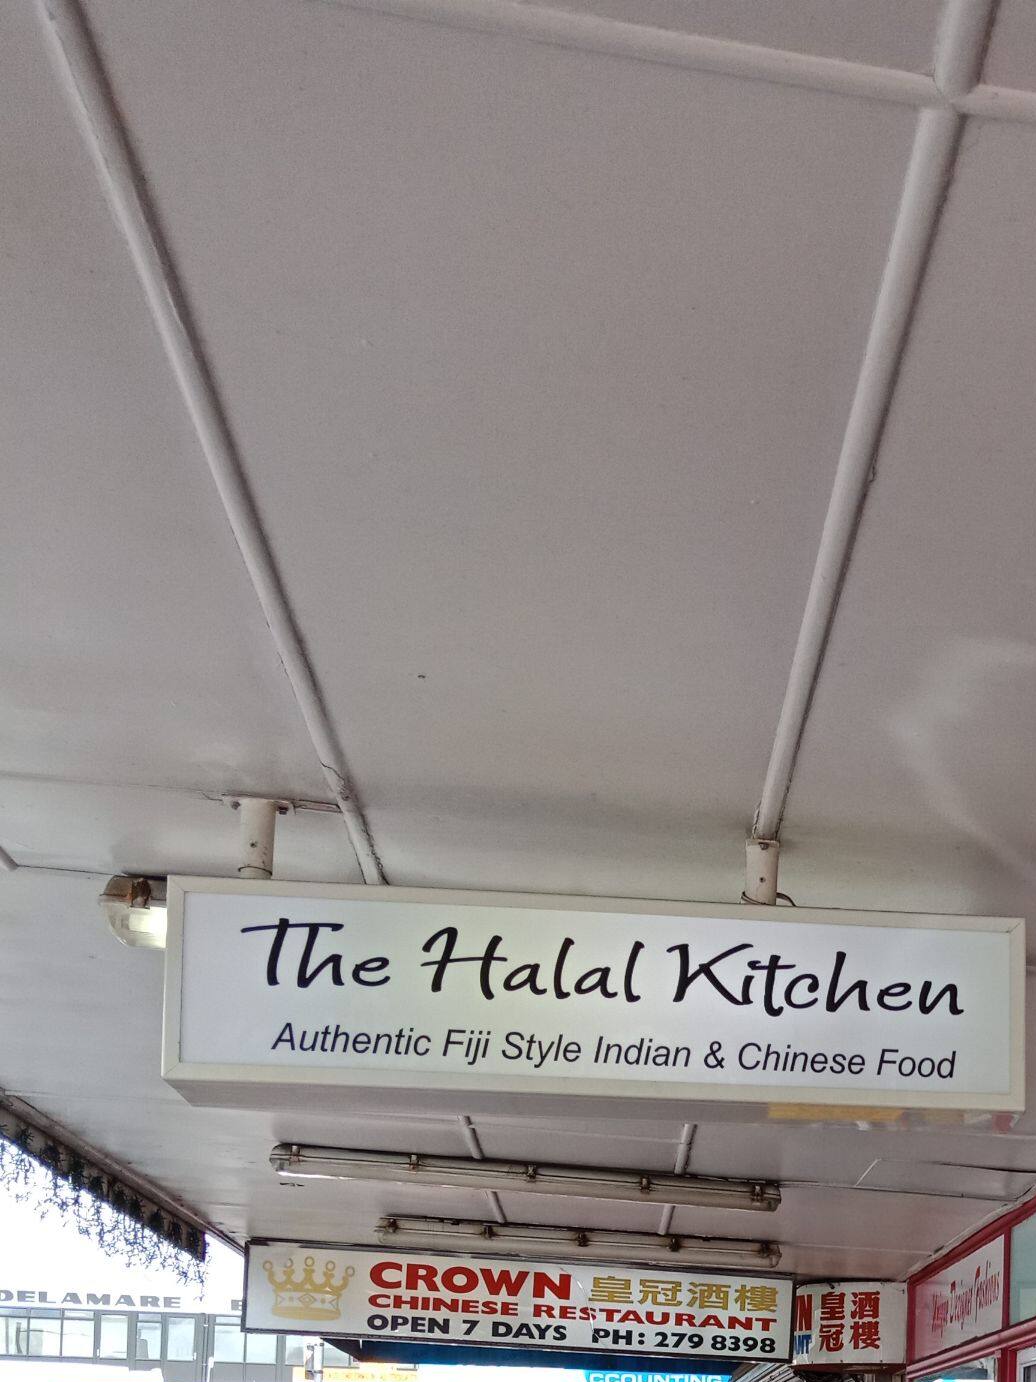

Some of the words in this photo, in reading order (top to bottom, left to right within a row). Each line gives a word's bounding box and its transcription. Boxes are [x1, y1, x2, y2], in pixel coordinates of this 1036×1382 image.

[241, 918, 392, 989] The
[421, 927, 641, 1002] Halal
[668, 942, 965, 1017] Kitchen
[272, 1022, 432, 1057] Authentic
[442, 1028, 490, 1063] Fiji
[501, 1030, 582, 1065] Style
[594, 1035, 691, 1069] Indian
[704, 1040, 726, 1070] &
[738, 1041, 866, 1075] Chinese
[877, 1048, 956, 1080] Food
[0, 1289, 181, 1309] DELAMARE
[369, 1261, 572, 1301] CROWN
[588, 1275, 779, 1312] 皇冠酒樓
[367, 1294, 519, 1319] CHINESE
[534, 1303, 778, 1332] RESTAURANT
[367, 1314, 450, 1335] OPEN
[462, 1320, 477, 1337] 7
[491, 1321, 568, 1342] DAYS
[653, 1331, 705, 1350] 279
[711, 1334, 777, 1354] 8398
